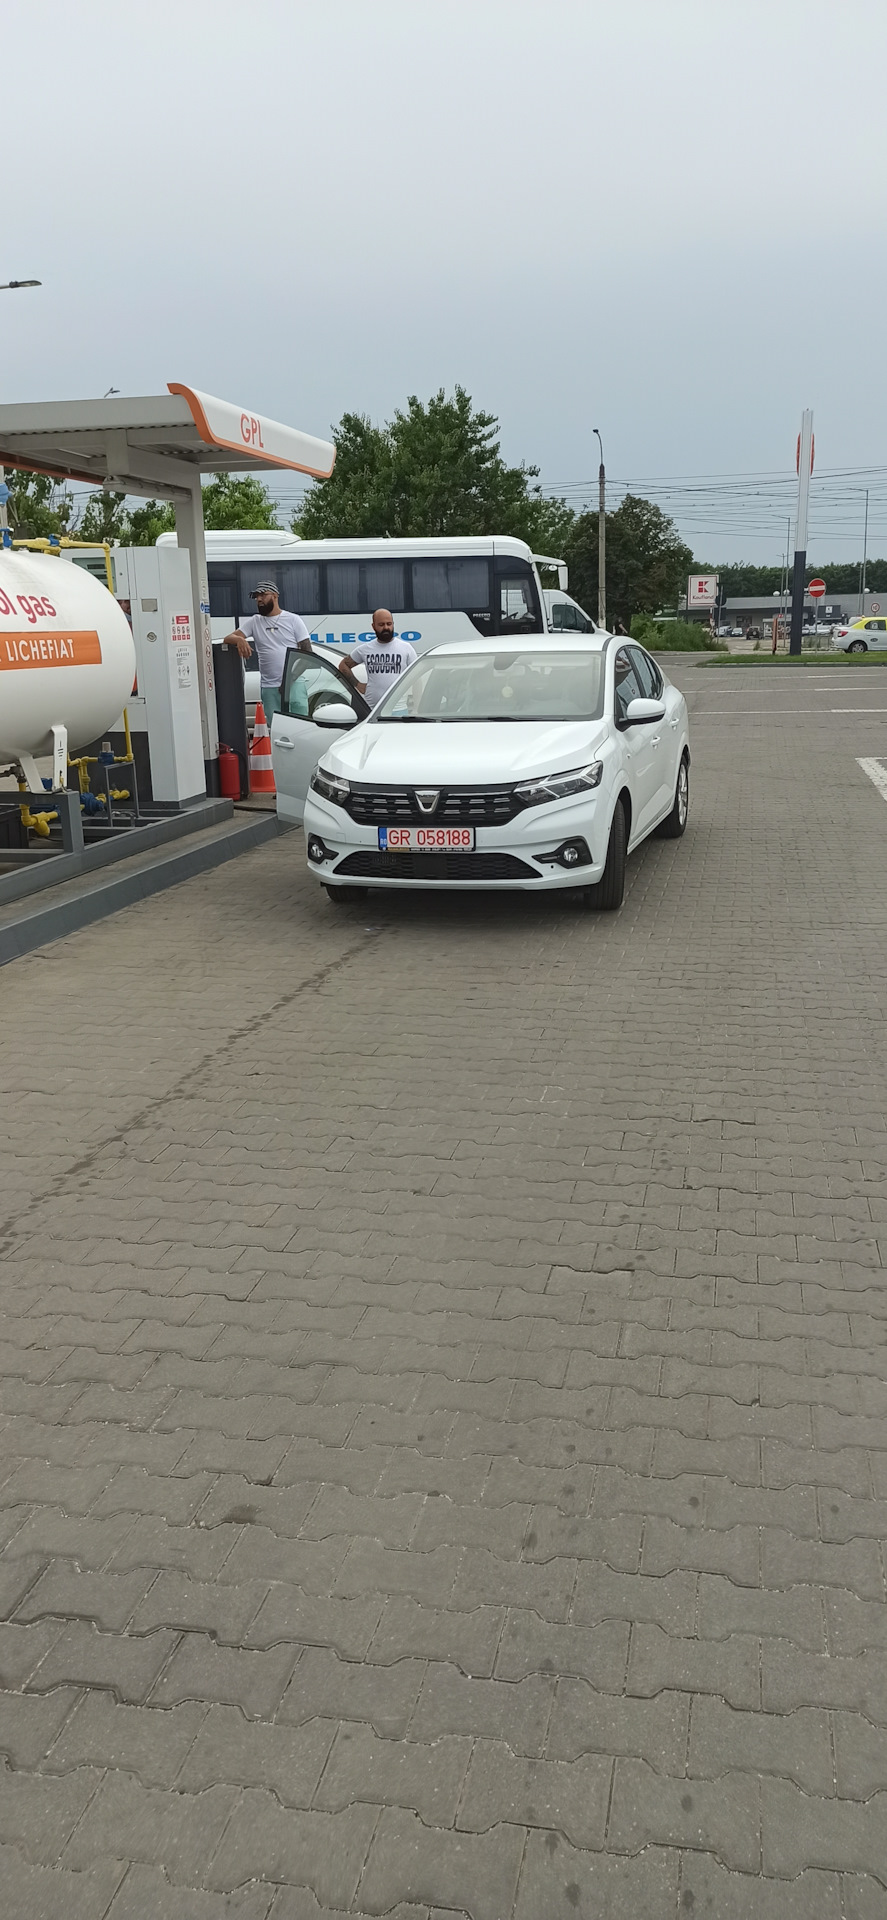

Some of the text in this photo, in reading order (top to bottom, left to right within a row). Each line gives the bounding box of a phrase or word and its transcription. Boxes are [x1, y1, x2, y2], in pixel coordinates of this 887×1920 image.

[240, 413, 264, 448] GPL
[16, 595, 57, 624] gas
[5, 639, 74, 661] LICHEFIAT
[388, 829, 470, 846] GR 058188
